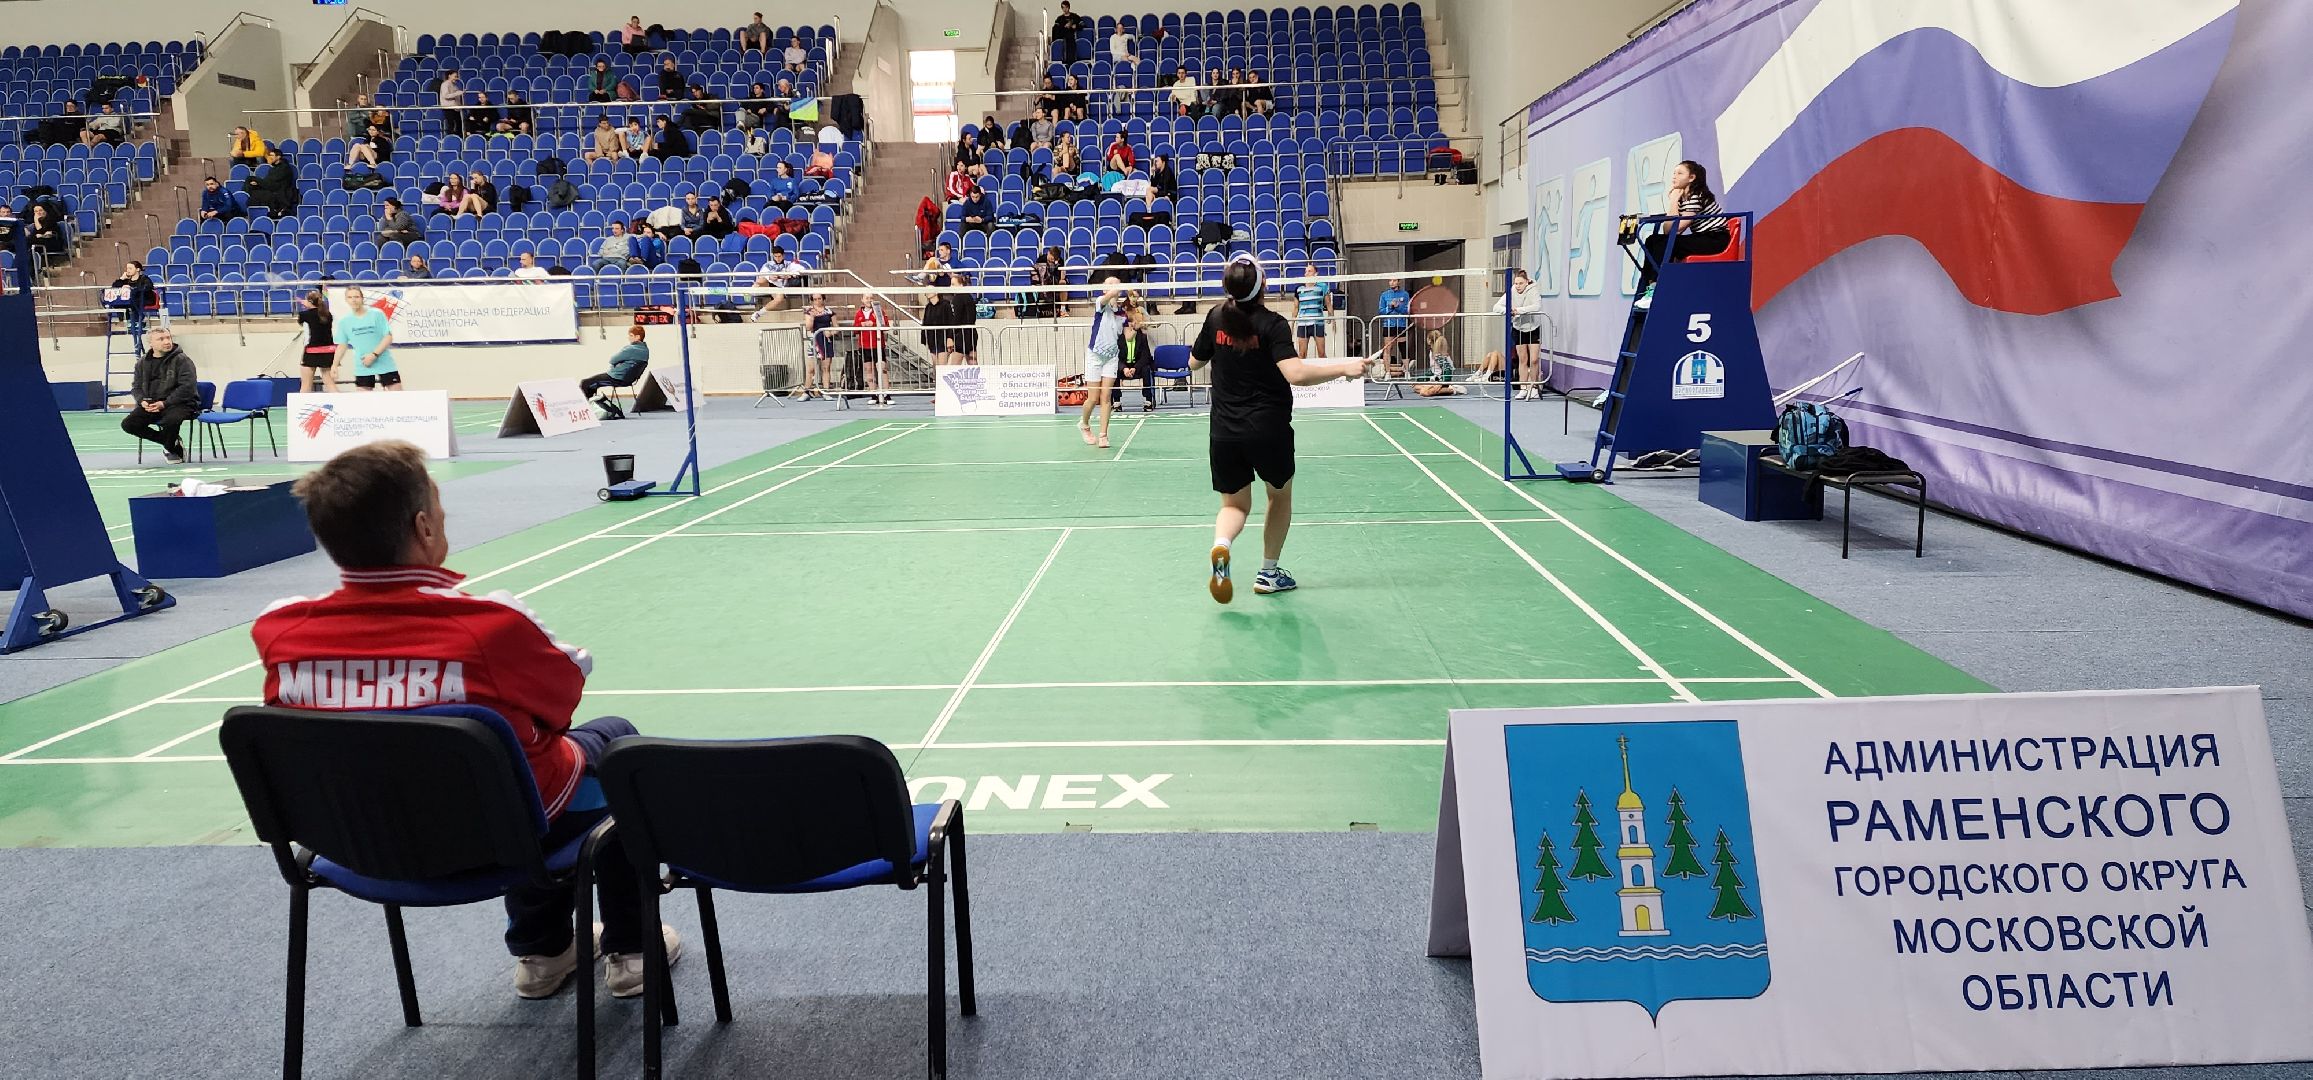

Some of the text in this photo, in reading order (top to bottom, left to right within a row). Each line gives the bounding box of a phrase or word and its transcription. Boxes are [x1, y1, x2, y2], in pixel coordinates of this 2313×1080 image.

[406, 306, 550, 318] НАЦИОНАЛЬНАЯ ФЕДЕРАЦИЯ
[407, 319, 479, 328] БАДМИНТОНА
[1686, 313, 1712, 343] 5
[408, 329, 449, 338] РОССИИ
[998, 400, 1051, 408] бадминтона
[1001, 391, 1049, 399] федерация
[278, 660, 466, 708] МОСКВА
[1824, 733, 2220, 781] АДМИНИСТРАЦИЯ
[903, 774, 1174, 810] ONEX
[1826, 792, 2231, 842] РАМЕНСКОГО
[1835, 858, 2247, 900] ГОРОДСКОГО ОКРУГА
[1893, 905, 2209, 954] МОСКОВСКОЙ
[1962, 971, 2174, 1011] ОБЛАСТИ
